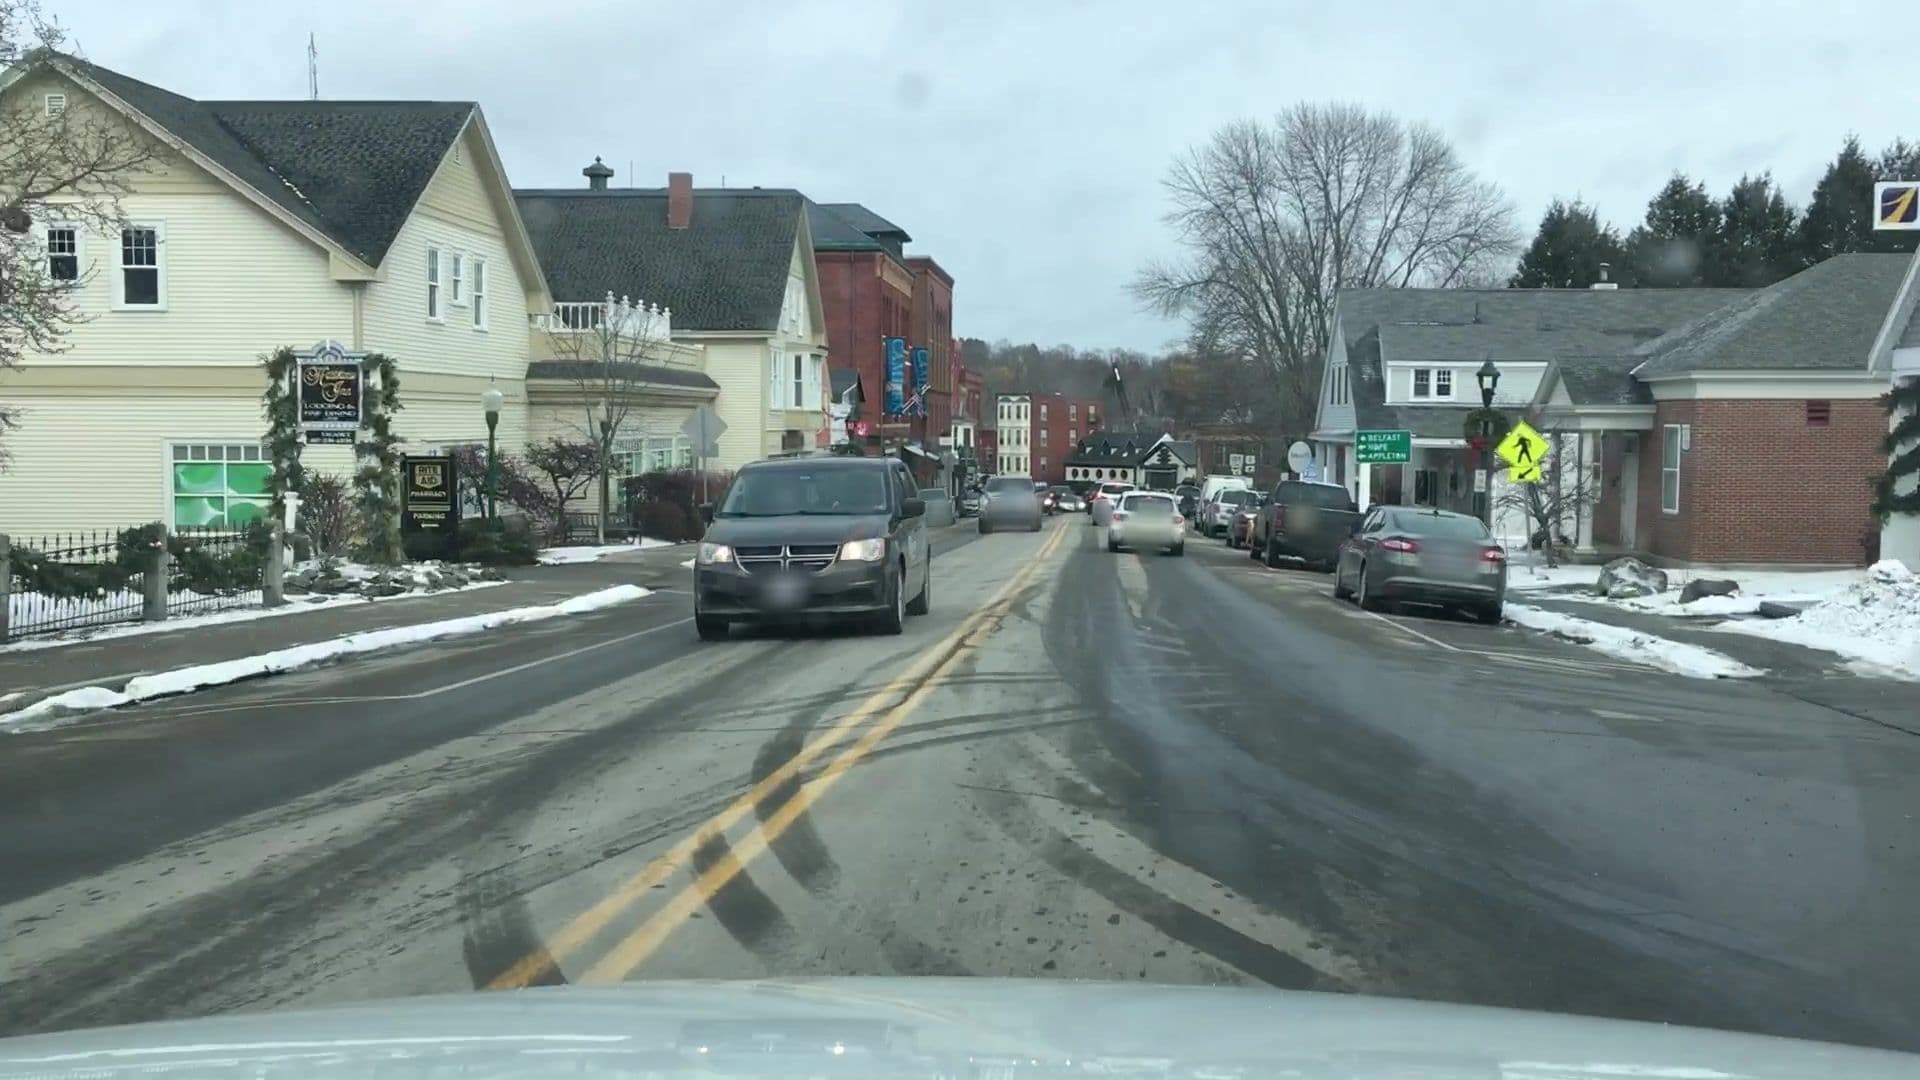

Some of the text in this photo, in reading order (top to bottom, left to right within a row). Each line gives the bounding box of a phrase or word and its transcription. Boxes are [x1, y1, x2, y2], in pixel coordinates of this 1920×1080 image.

[1368, 433, 1401, 441] BELFAST
[1368, 452, 1407, 460] APPLETON
[417, 466, 439, 475] RITE
[420, 476, 438, 485] AID
